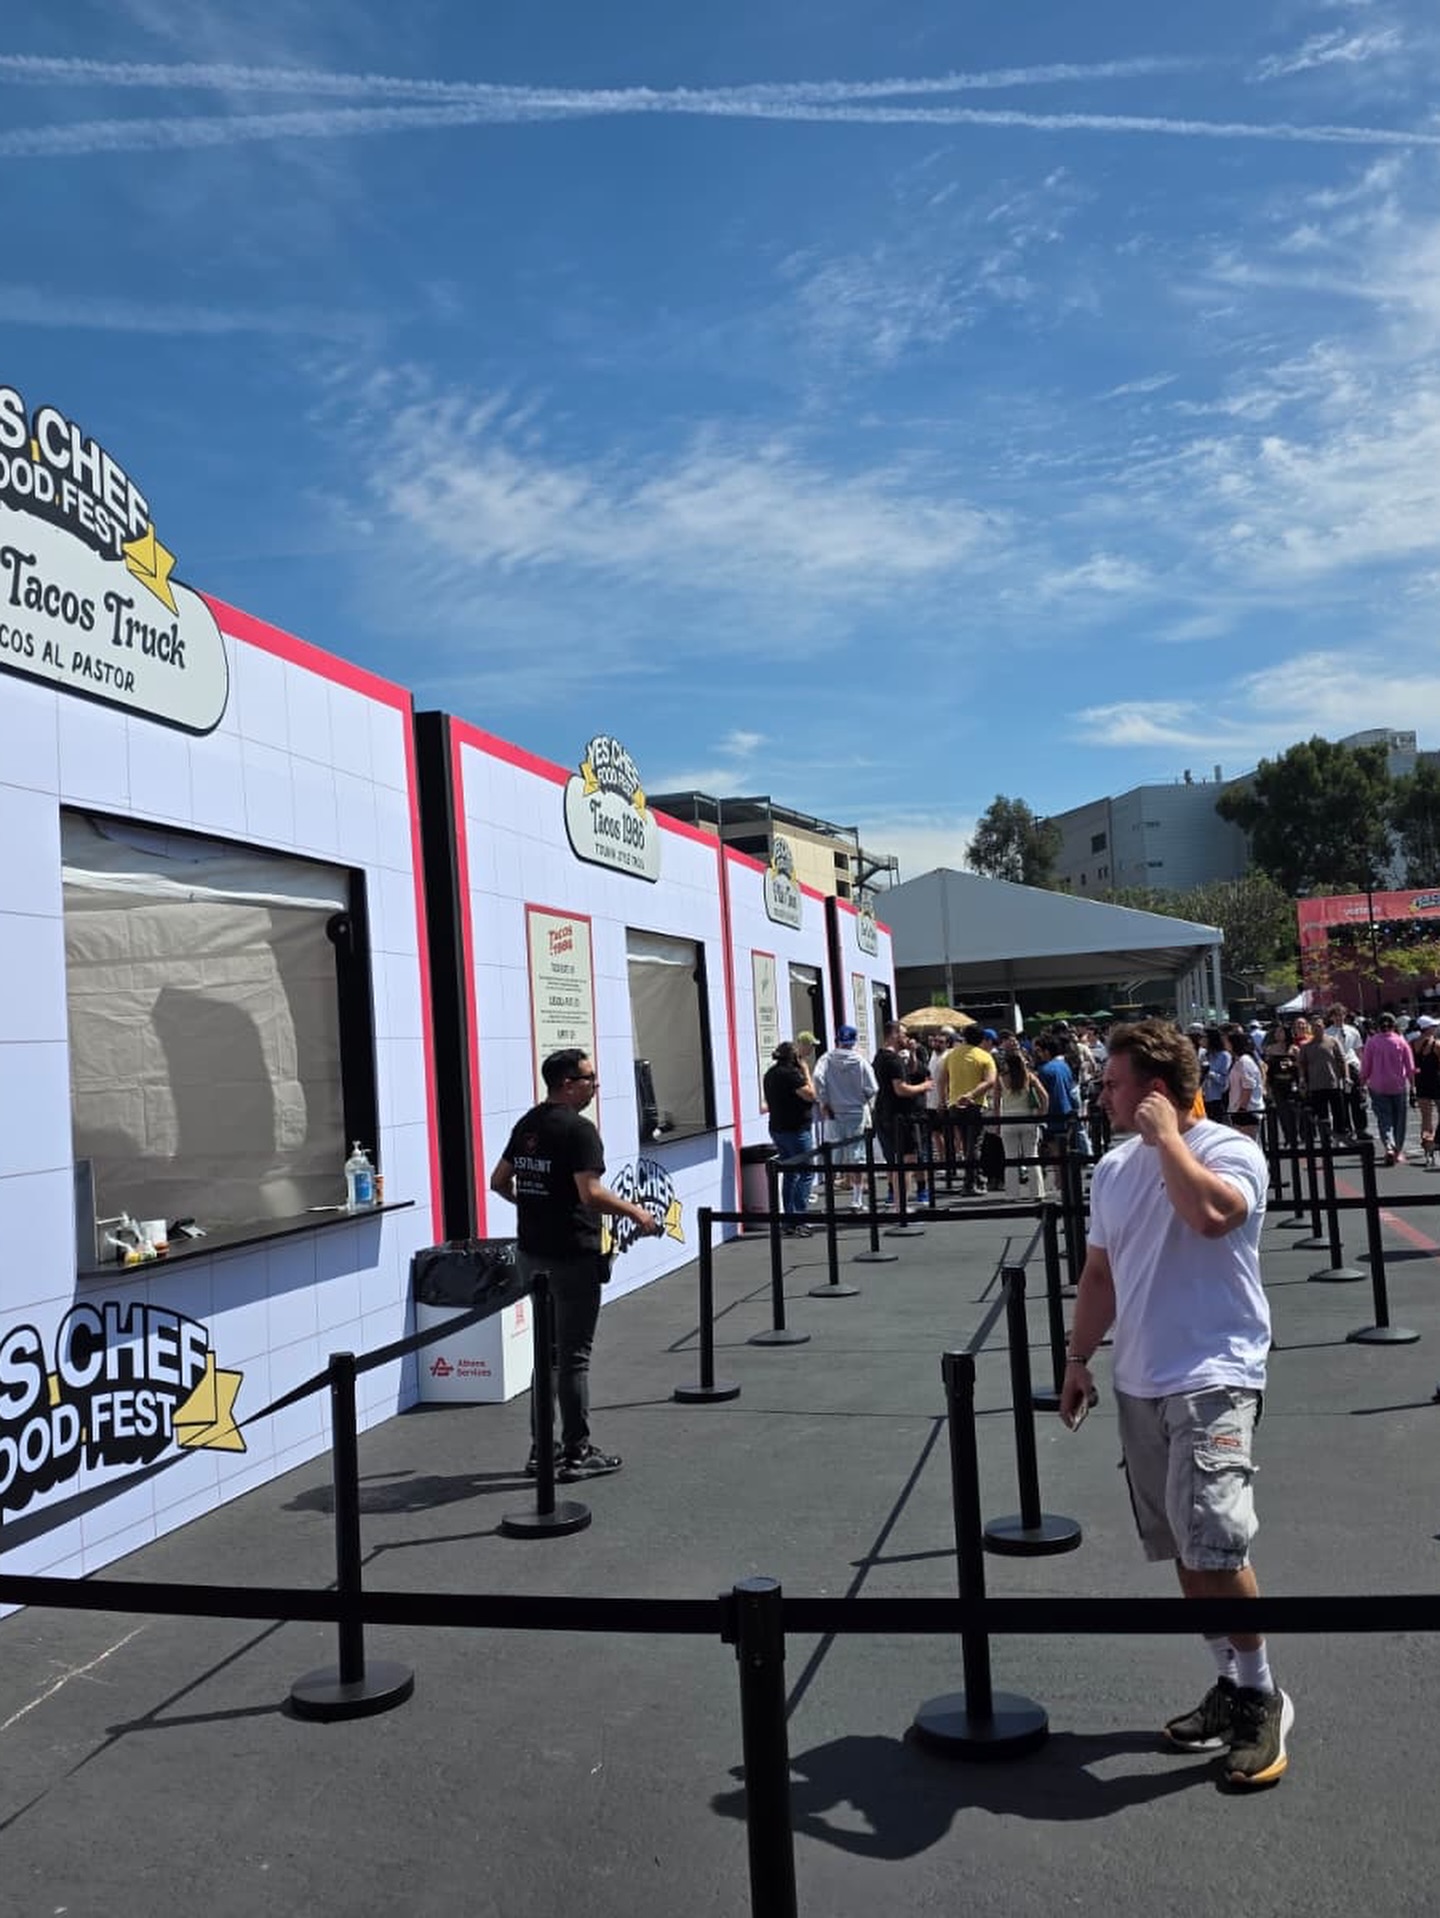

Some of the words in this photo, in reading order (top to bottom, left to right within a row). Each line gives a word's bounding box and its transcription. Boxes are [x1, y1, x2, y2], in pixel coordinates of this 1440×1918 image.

[37, 407, 149, 537] CHEF
[61, 478, 127, 557] FEST
[0, 546, 96, 632] Tacos
[103, 590, 186, 670] Truck
[41, 640, 65, 670] AL
[71, 650, 136, 693] PASTOR
[587, 736, 611, 769] YES
[589, 798, 622, 841] Tacos
[622, 811, 646, 851] 1986
[610, 1167, 634, 1204] ES
[56, 1304, 209, 1390] CHEF
[90, 1390, 177, 1444] FEST
